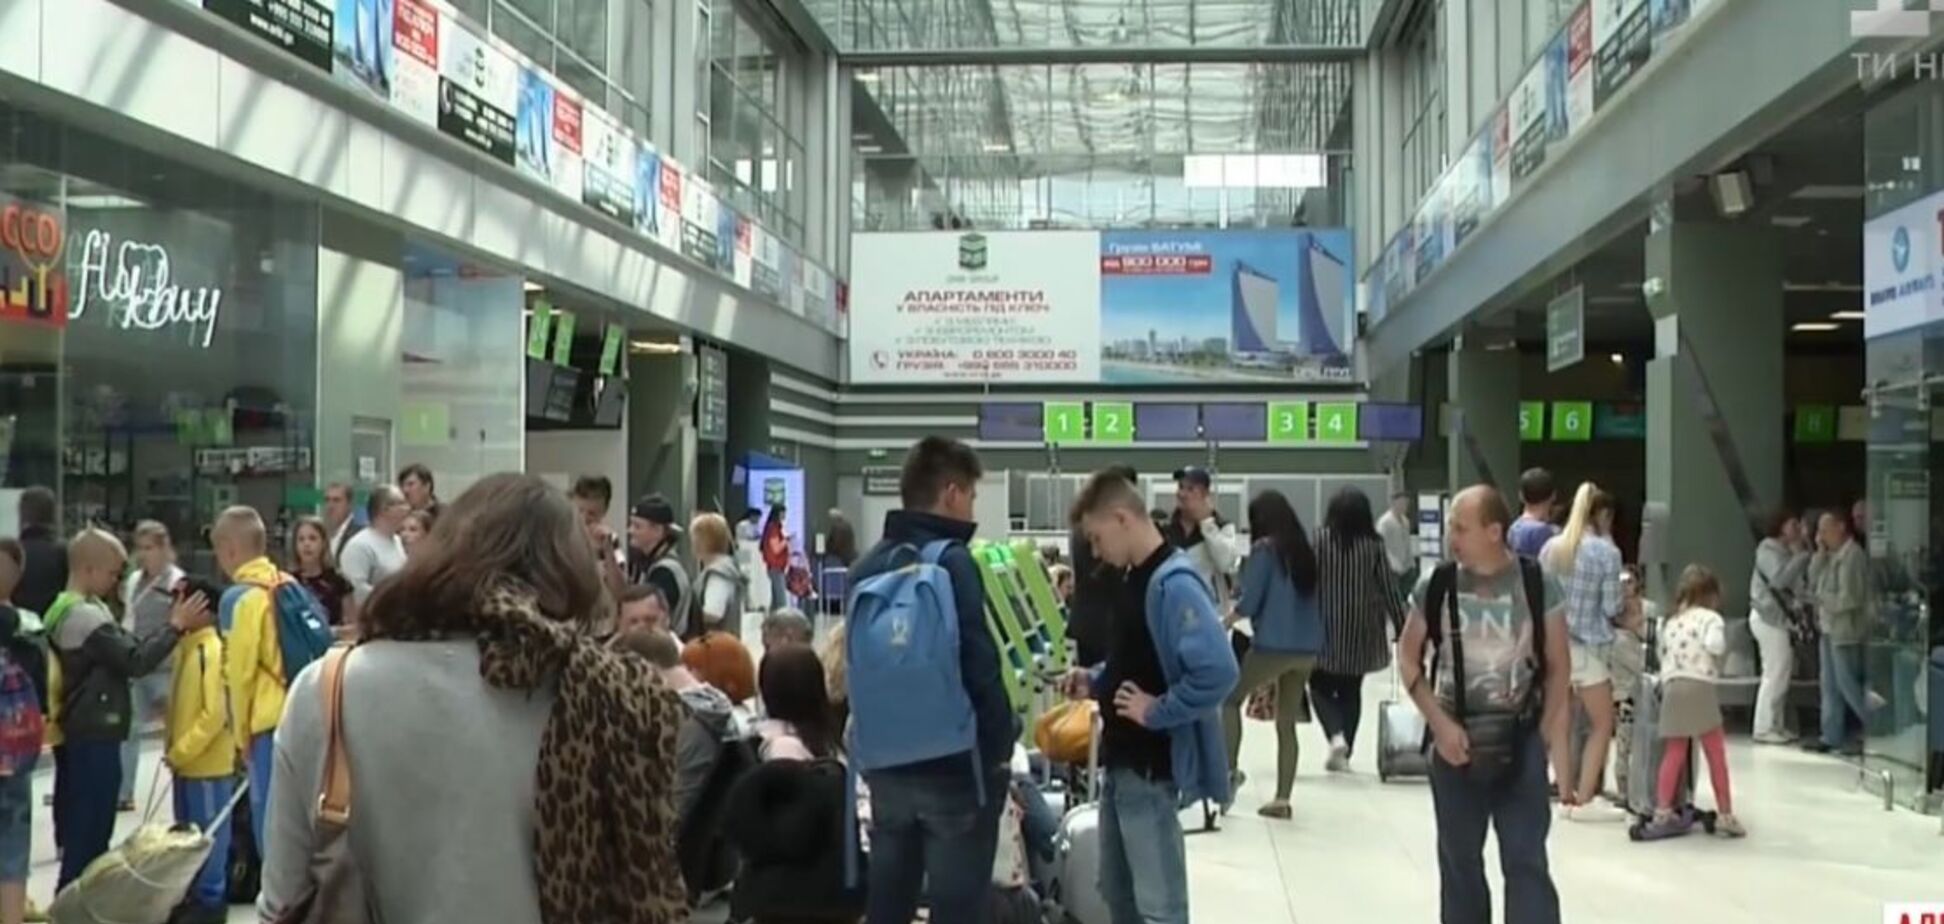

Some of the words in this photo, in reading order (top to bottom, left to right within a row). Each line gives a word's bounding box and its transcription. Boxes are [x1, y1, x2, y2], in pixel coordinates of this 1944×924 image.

[904, 290, 1044, 302] АПАРТАМЕНТИ
[907, 303, 981, 313] ВЛАСНІСТЬ
[1057, 414, 1068, 430] 1
[1105, 413, 1118, 430] 2
[1280, 413, 1293, 431] 3
[1328, 413, 1342, 431] 4
[1520, 411, 1529, 431] 5
[1565, 411, 1579, 431] 6
